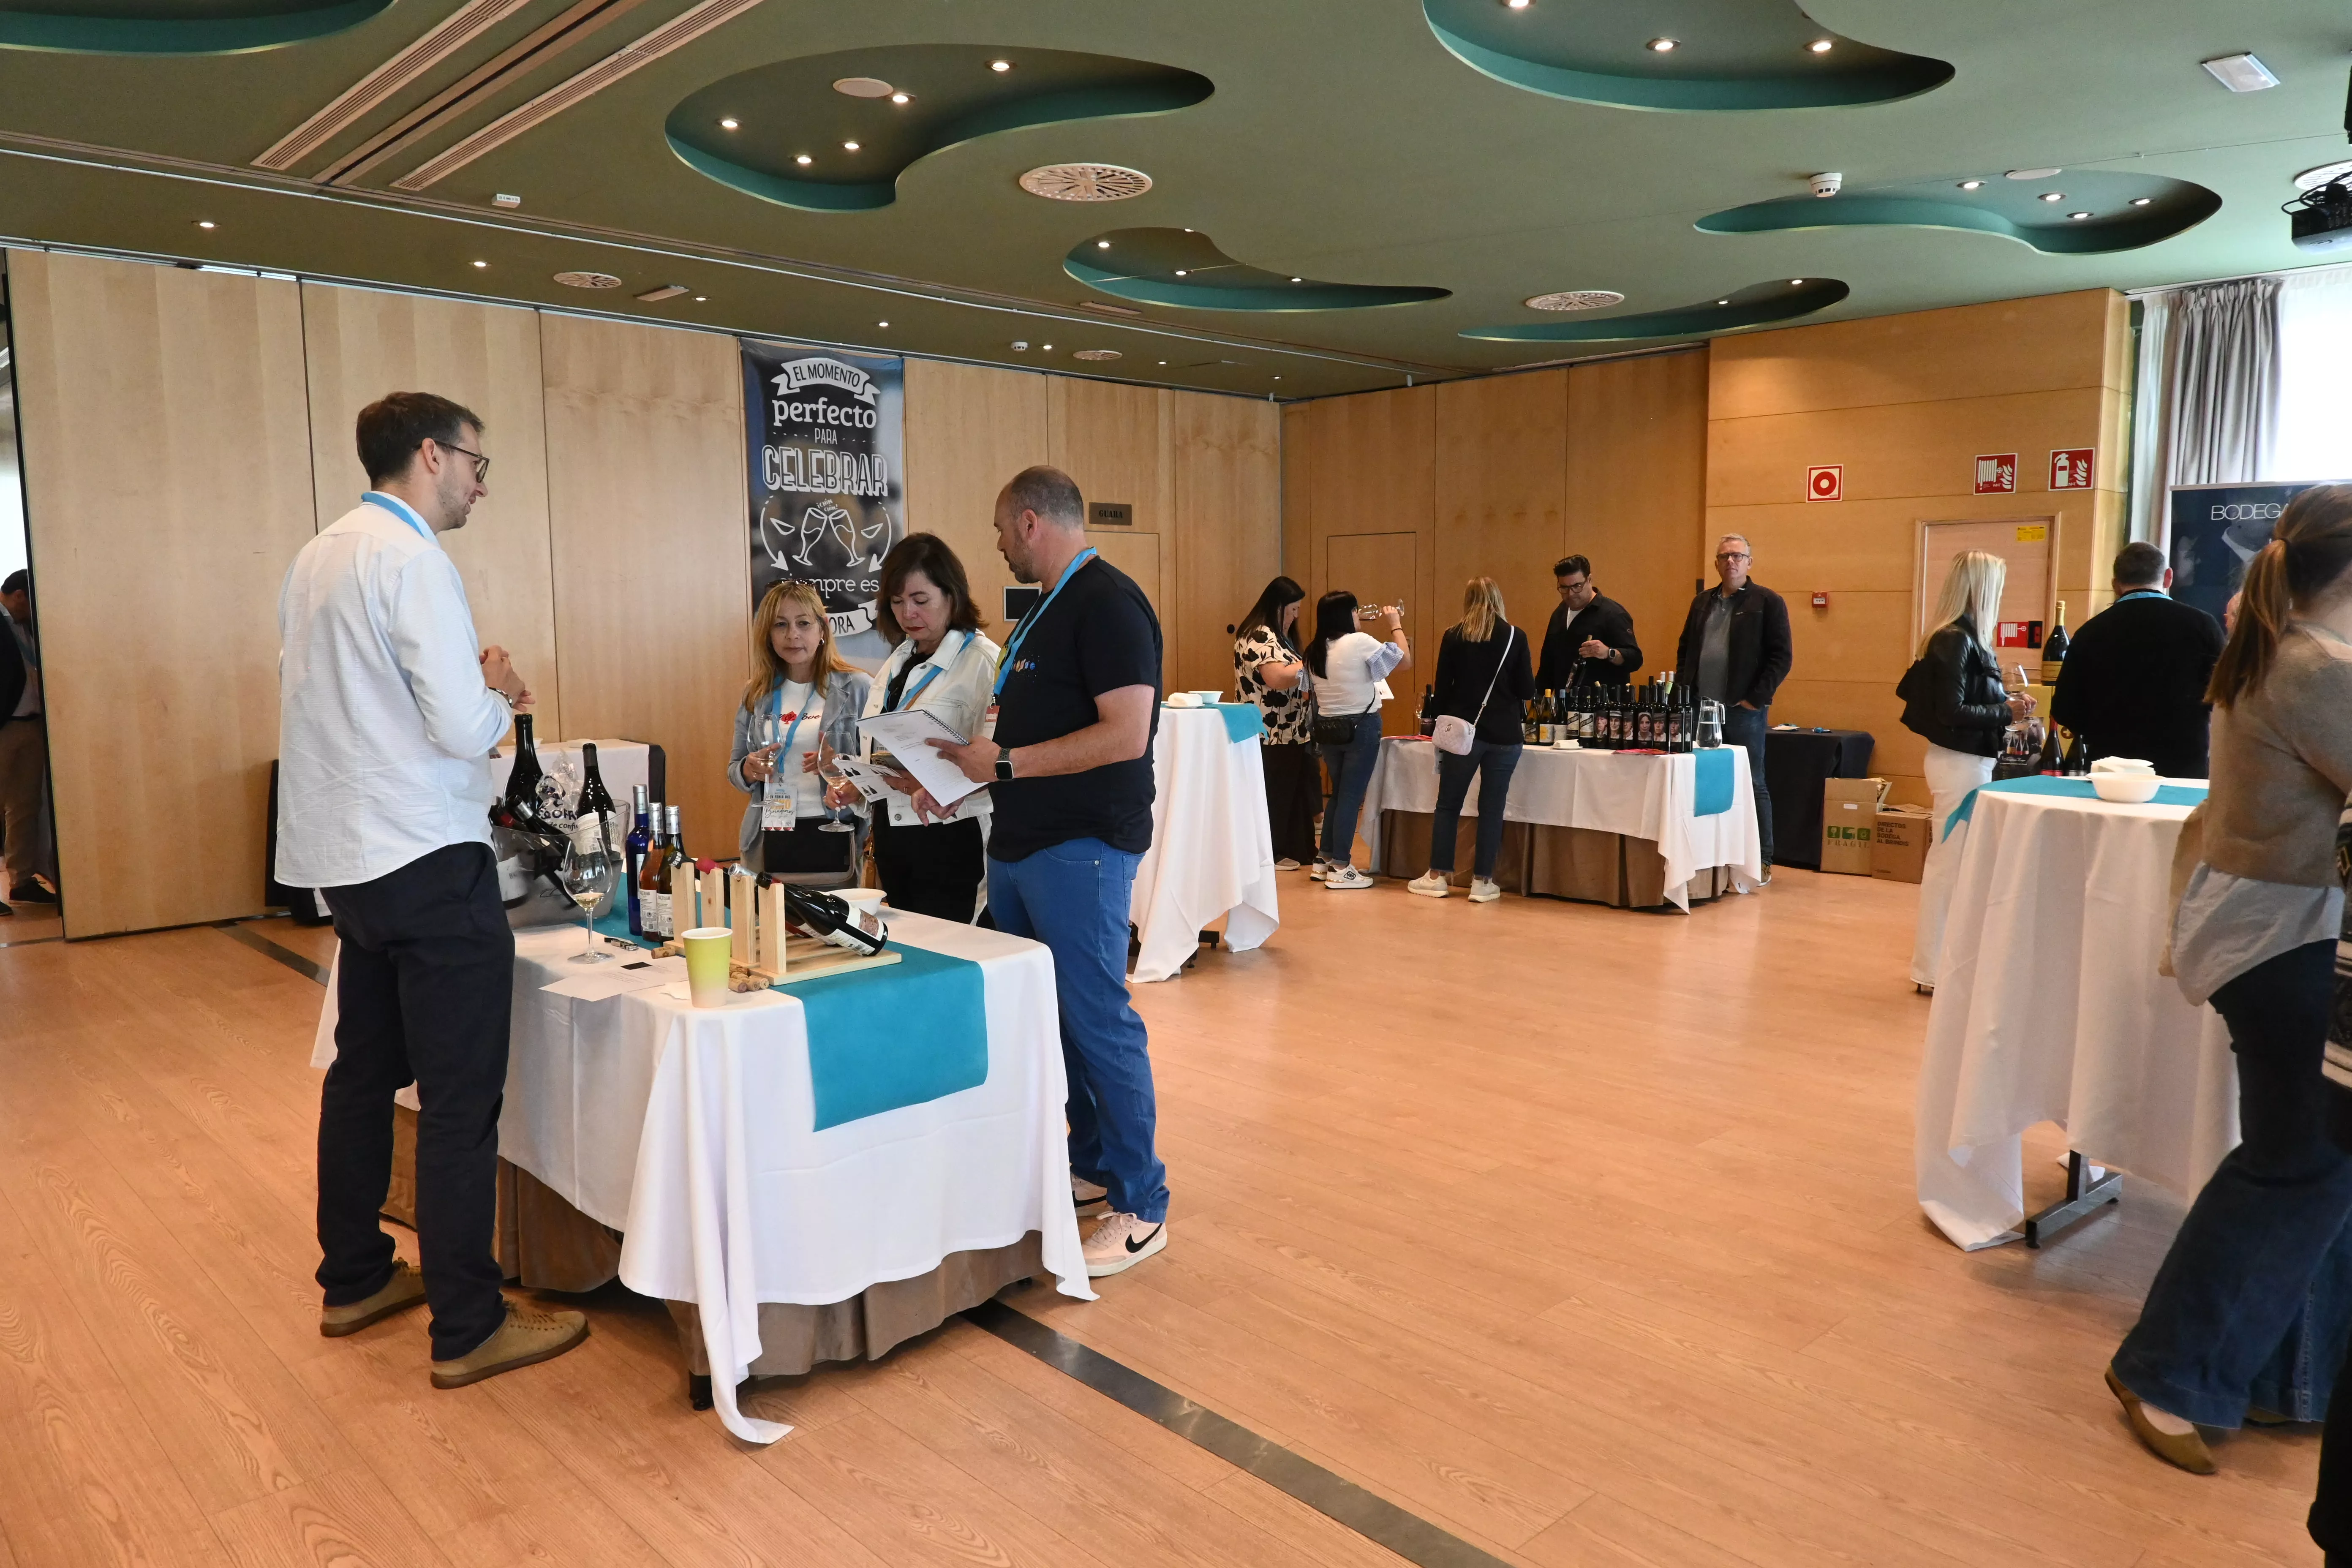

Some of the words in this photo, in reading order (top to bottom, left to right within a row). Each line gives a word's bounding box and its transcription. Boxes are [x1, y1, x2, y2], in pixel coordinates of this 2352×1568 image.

[792, 365, 806, 381] EL
[807, 363, 860, 387] MOMENTO
[772, 397, 877, 429] perfecto
[814, 427, 838, 445] PARA
[762, 444, 888, 497] CELEBRAR
[860, 579, 880, 592] es
[829, 615, 855, 635] ORA
